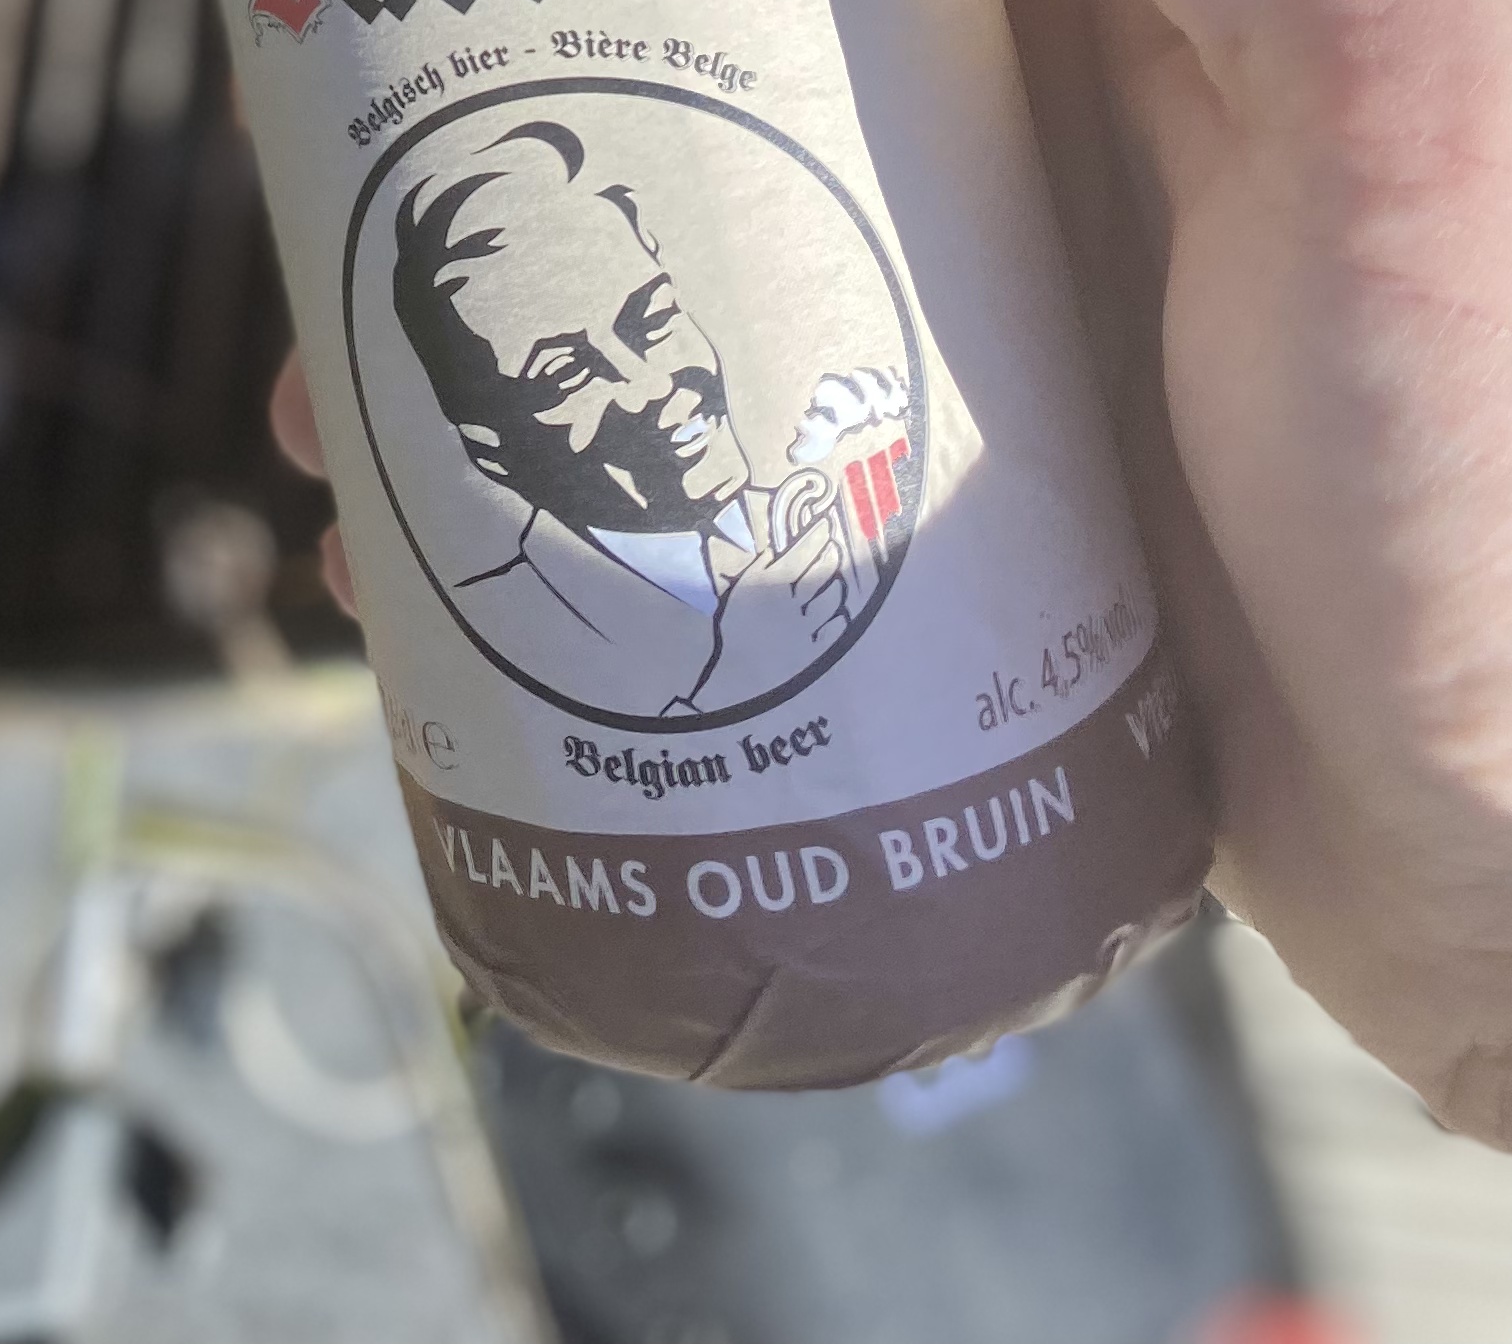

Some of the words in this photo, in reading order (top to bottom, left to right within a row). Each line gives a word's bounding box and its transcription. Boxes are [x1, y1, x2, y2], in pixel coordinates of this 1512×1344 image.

[347, 62, 446, 148] Belgisch
[447, 42, 509, 79] bier
[550, 29, 652, 63] Bière
[661, 36, 759, 92] Belge
[975, 671, 1038, 732] alc.
[562, 735, 733, 801] Belgian
[737, 715, 832, 775] beer
[433, 816, 658, 917] VLAAMS
[686, 846, 850, 919] OUD
[878, 765, 1076, 891] BRUIN
